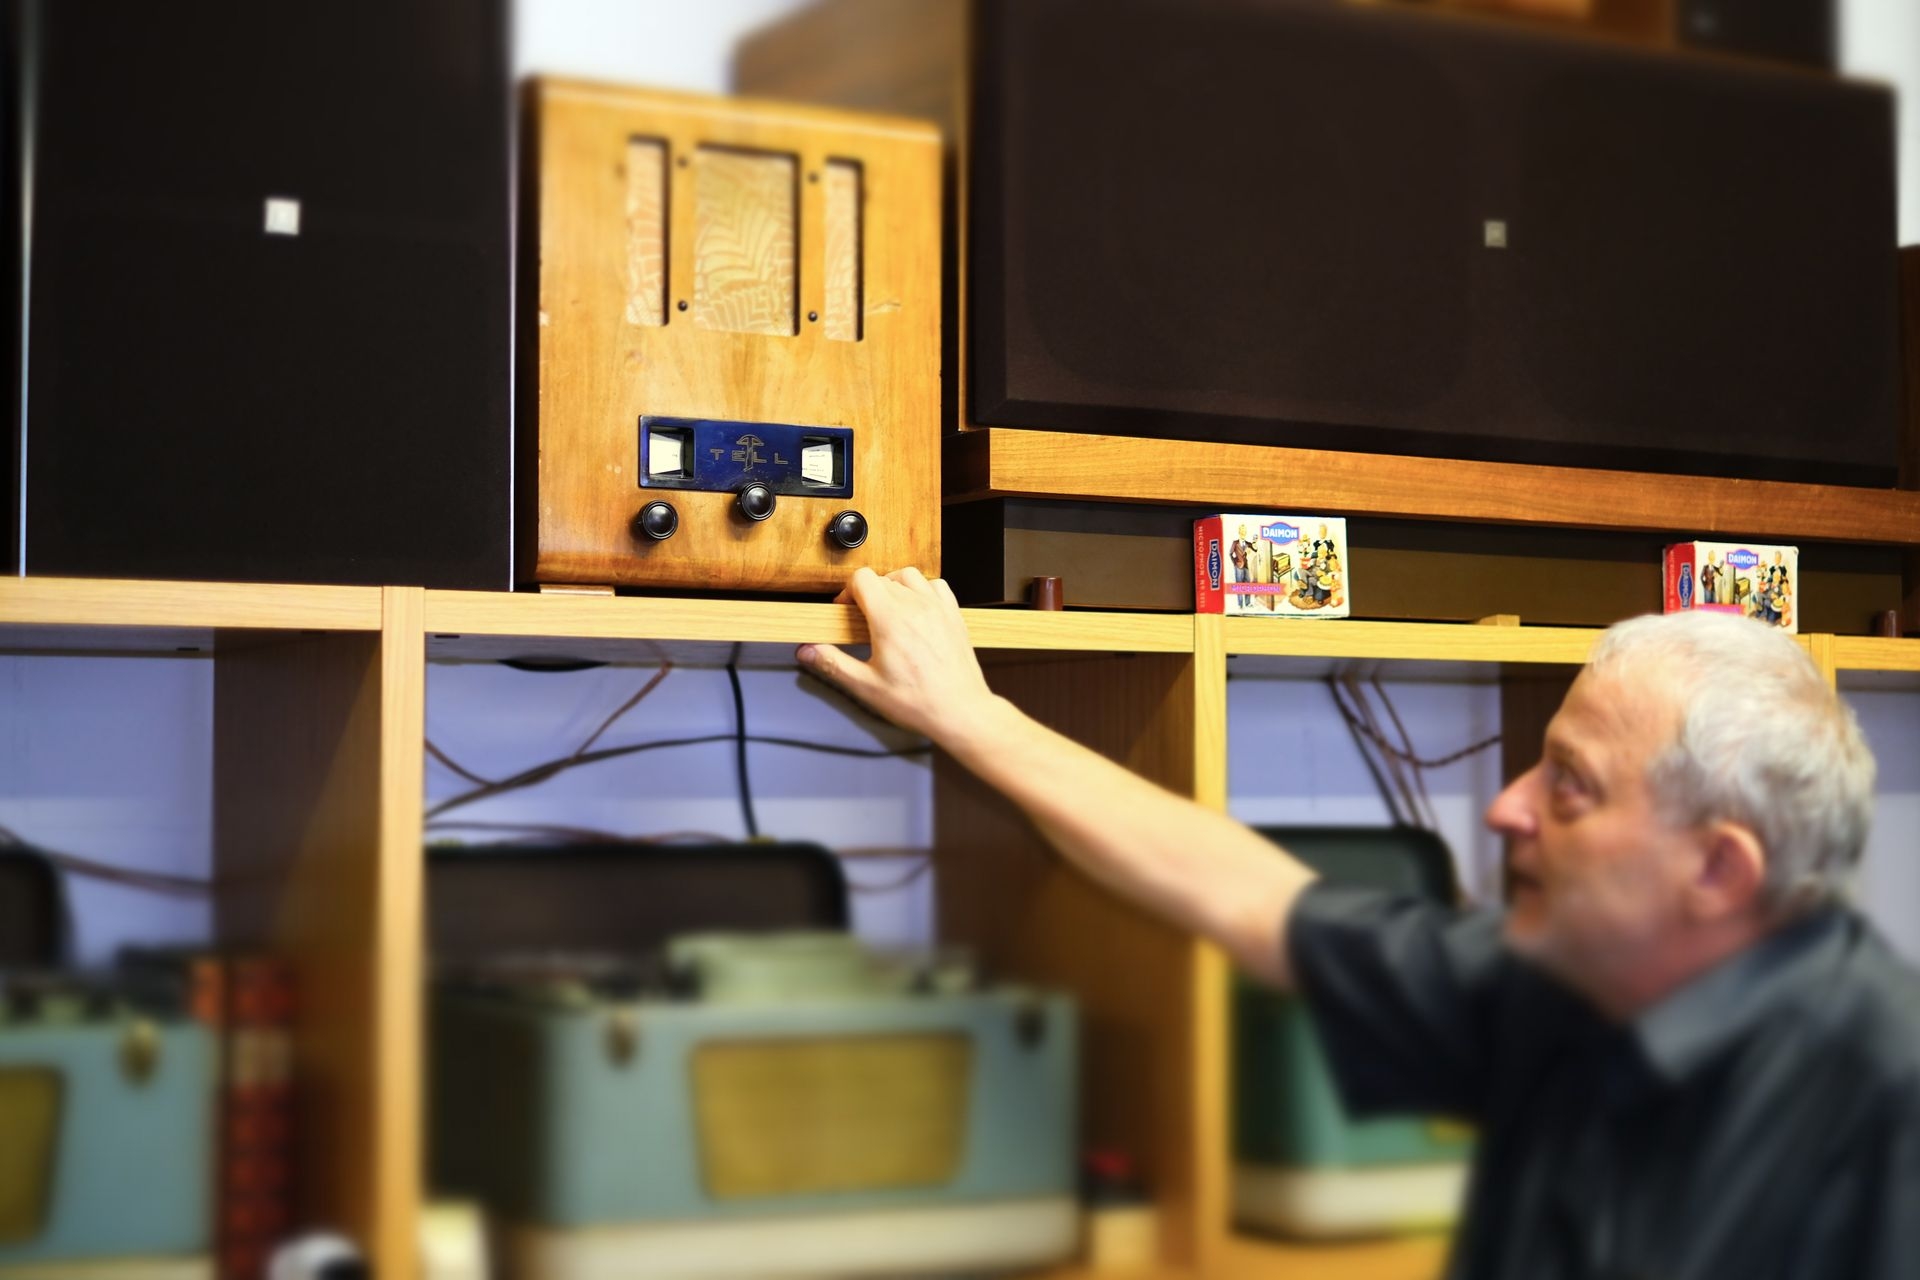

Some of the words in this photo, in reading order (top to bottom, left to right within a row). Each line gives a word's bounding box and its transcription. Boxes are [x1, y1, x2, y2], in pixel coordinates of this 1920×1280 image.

[709, 448, 789, 465] TELL
[1262, 527, 1298, 538] DAIMON
[1727, 553, 1757, 564] DAIMON
[1682, 566, 1690, 606] DAIMON
